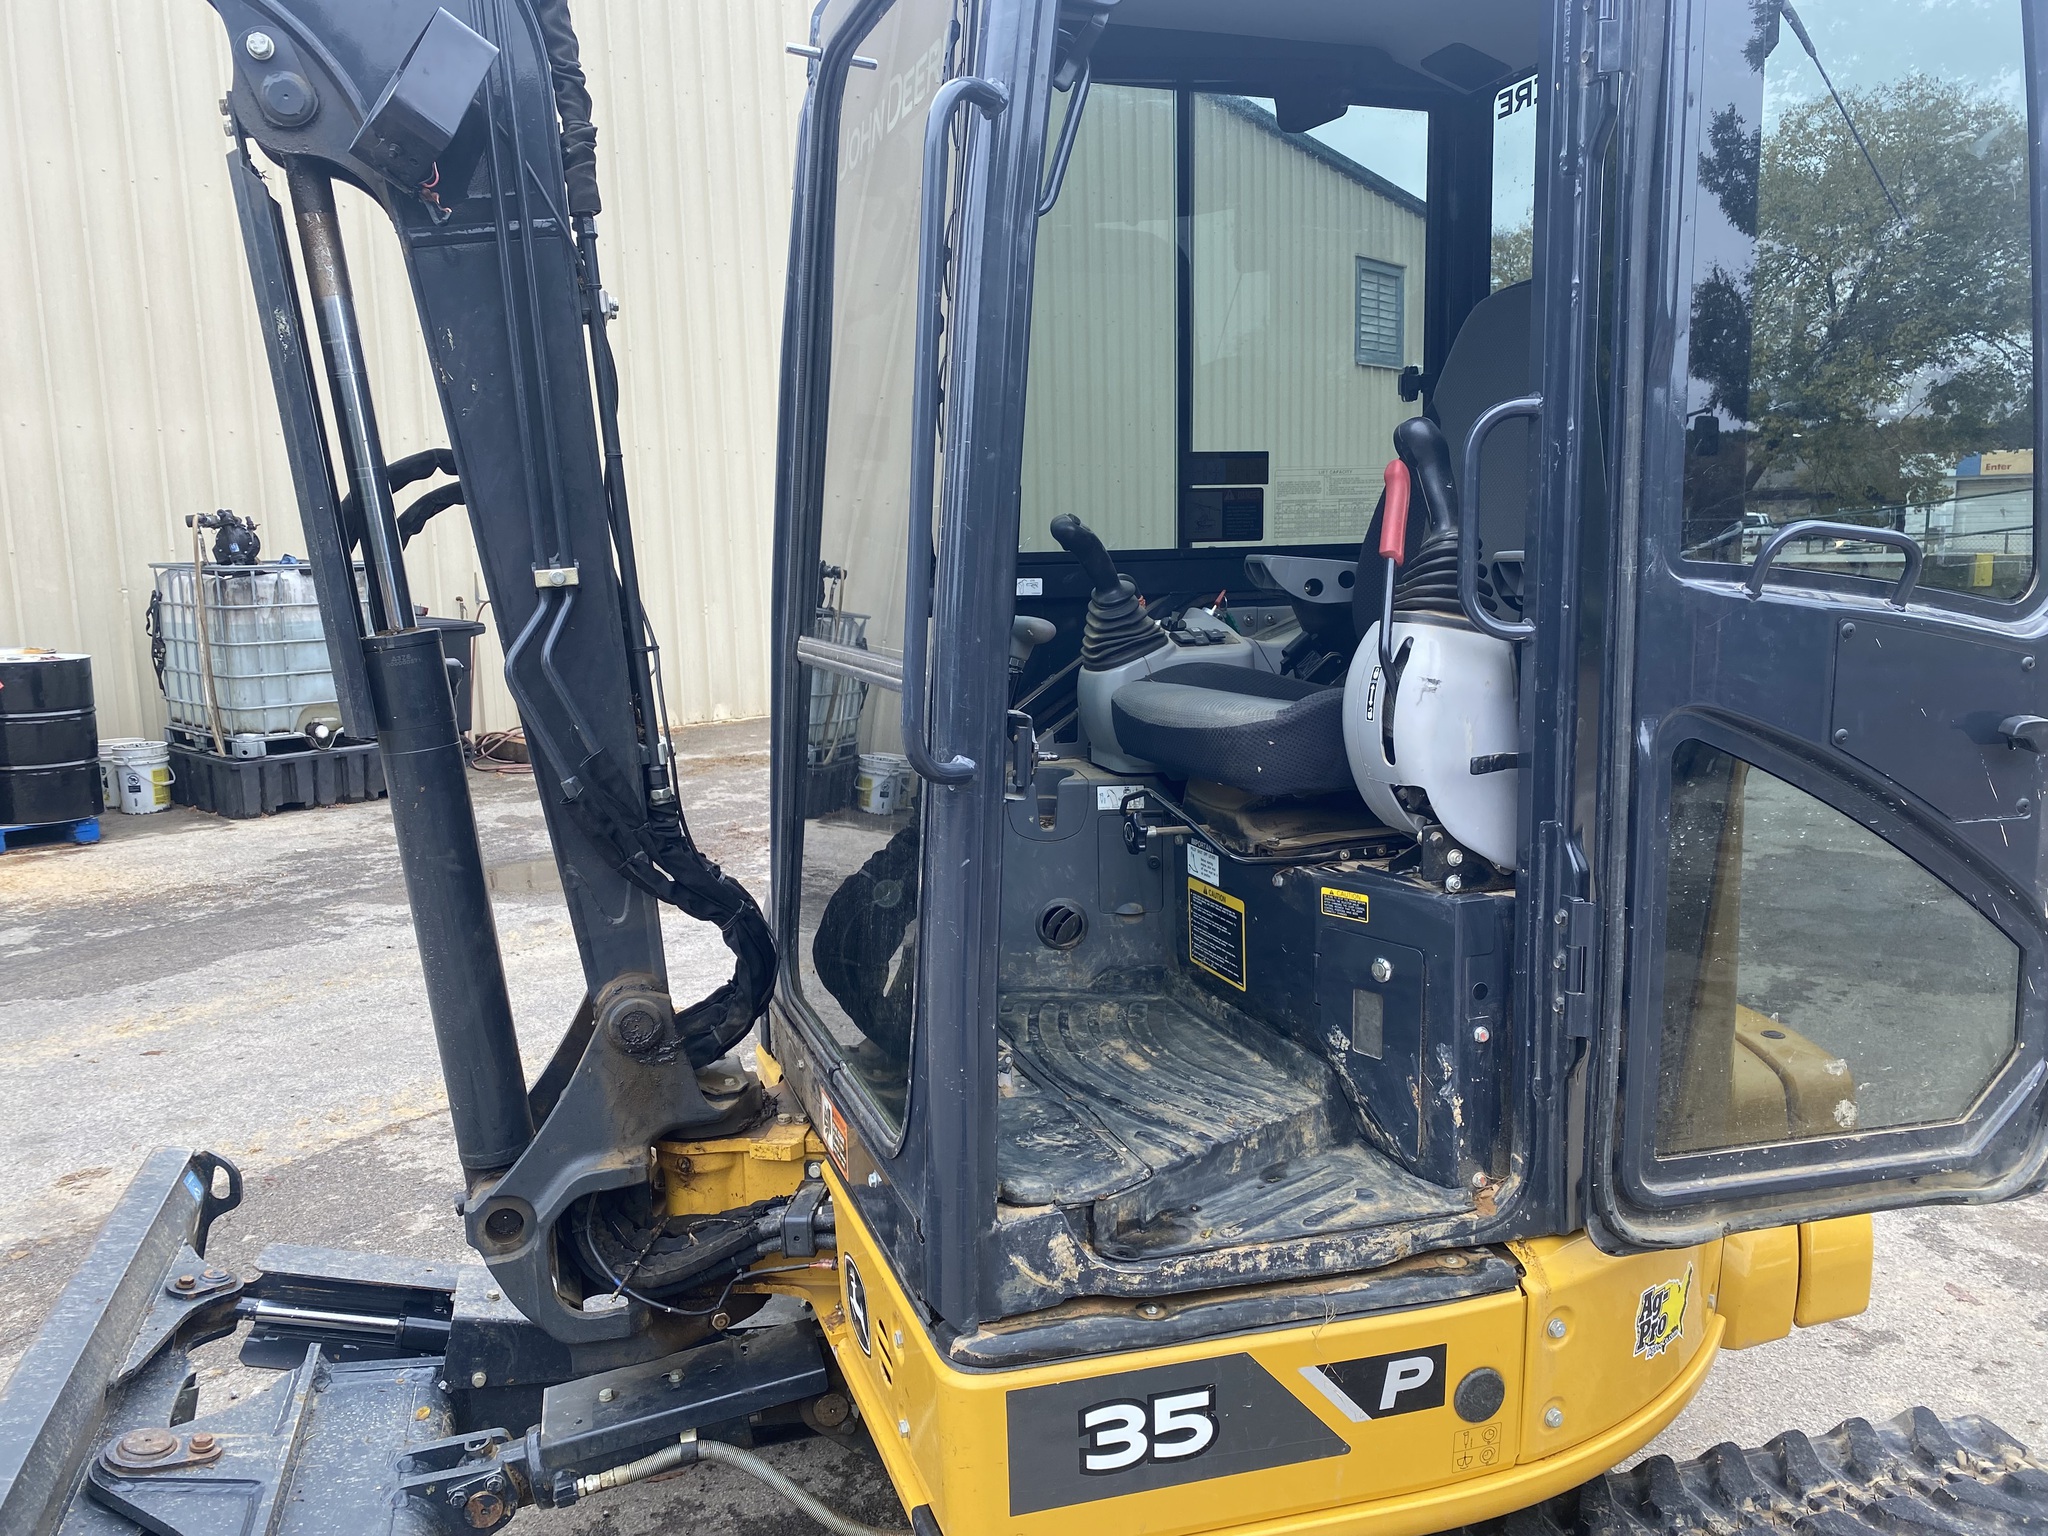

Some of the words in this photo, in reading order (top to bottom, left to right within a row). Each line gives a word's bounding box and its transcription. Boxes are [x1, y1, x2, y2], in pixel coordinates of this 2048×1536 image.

[839, 98, 886, 182] JOHN
[1985, 463, 2012, 471] Enter
[1208, 889, 1227, 903] CAUTION
[1336, 890, 1361, 900] CAUTION
[1639, 1288, 1669, 1323] Ag-
[1636, 1313, 1668, 1352] Pro
[1378, 1356, 1434, 1411] P
[1082, 1389, 1217, 1472] 35
